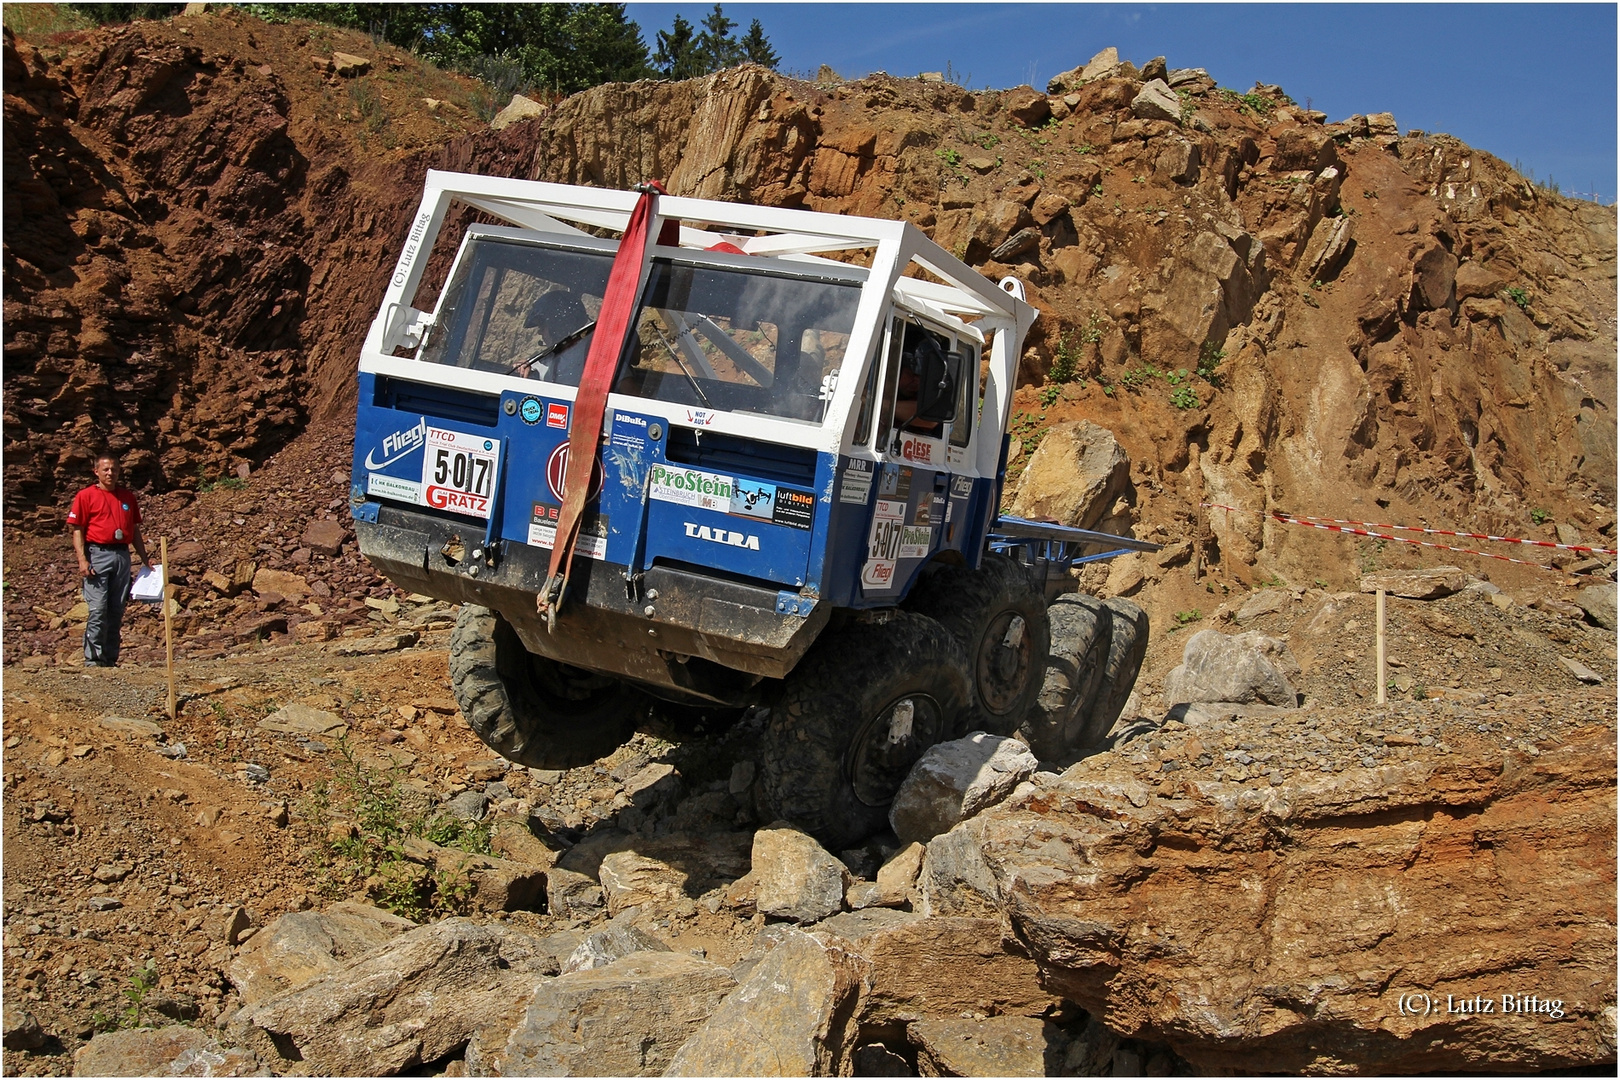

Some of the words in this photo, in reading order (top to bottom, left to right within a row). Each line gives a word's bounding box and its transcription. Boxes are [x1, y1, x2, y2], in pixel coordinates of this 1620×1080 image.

[549, 412, 565, 420] DMV
[615, 413, 647, 426] DiBuKa
[382, 416, 426, 457] Fliegl
[430, 429, 455, 442] TTCD
[848, 458, 867, 471] MRR
[386, 481, 415, 492] BALKONBAU
[653, 466, 731, 498] ProStein
[426, 485, 487, 512] GRÄTZ
[777, 491, 813, 504] luftbild
[779, 499, 809, 508] DIGITAL
[877, 502, 889, 511] TTCD
[683, 522, 760, 550] TATRA
[872, 563, 894, 582] Fliegl
